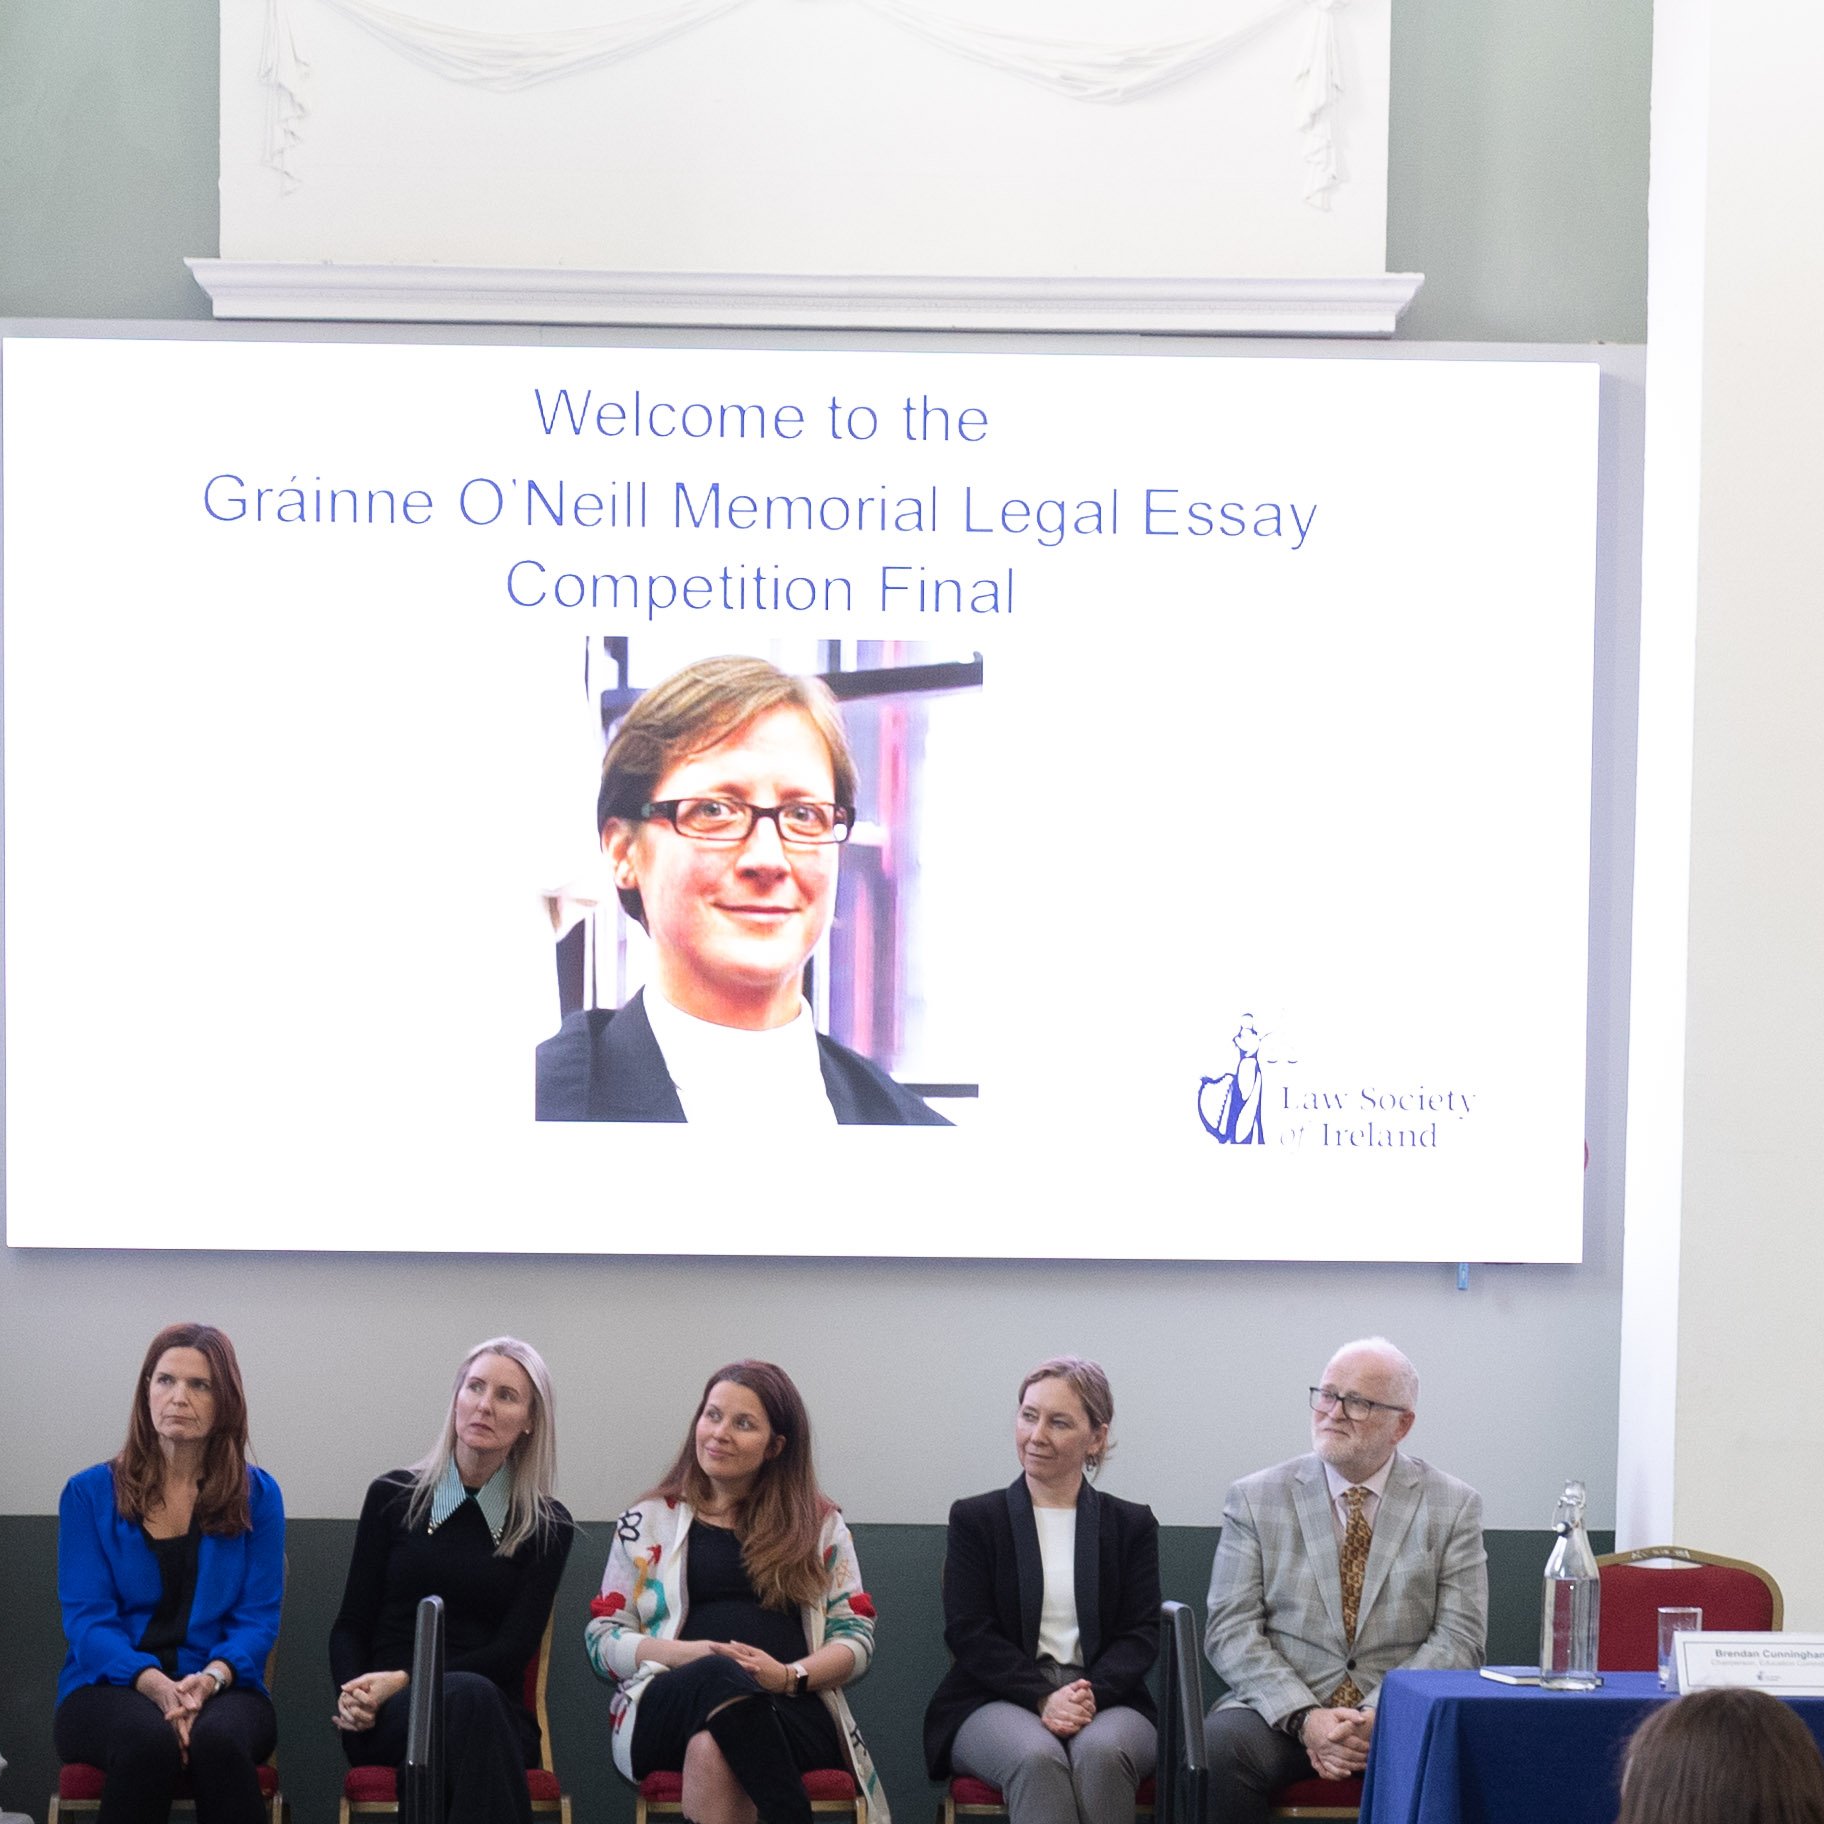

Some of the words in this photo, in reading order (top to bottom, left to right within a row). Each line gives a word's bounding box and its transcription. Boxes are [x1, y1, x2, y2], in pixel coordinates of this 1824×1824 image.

[534, 388, 805, 440] Welcome
[827, 395, 878, 441] to
[902, 394, 989, 442] the
[203, 473, 433, 525] Gráinne
[459, 477, 646, 528] O'Neill
[675, 481, 937, 532] Memorial
[965, 486, 1118, 547] Legal
[1145, 488, 1318, 551] Essay
[507, 559, 851, 622] Competition
[881, 566, 1013, 614] Final
[1281, 1086, 1349, 1111] Law
[1360, 1085, 1476, 1120] Society
[1322, 1121, 1437, 1148] Ireland
[1715, 1649, 1760, 1658] Brendan
